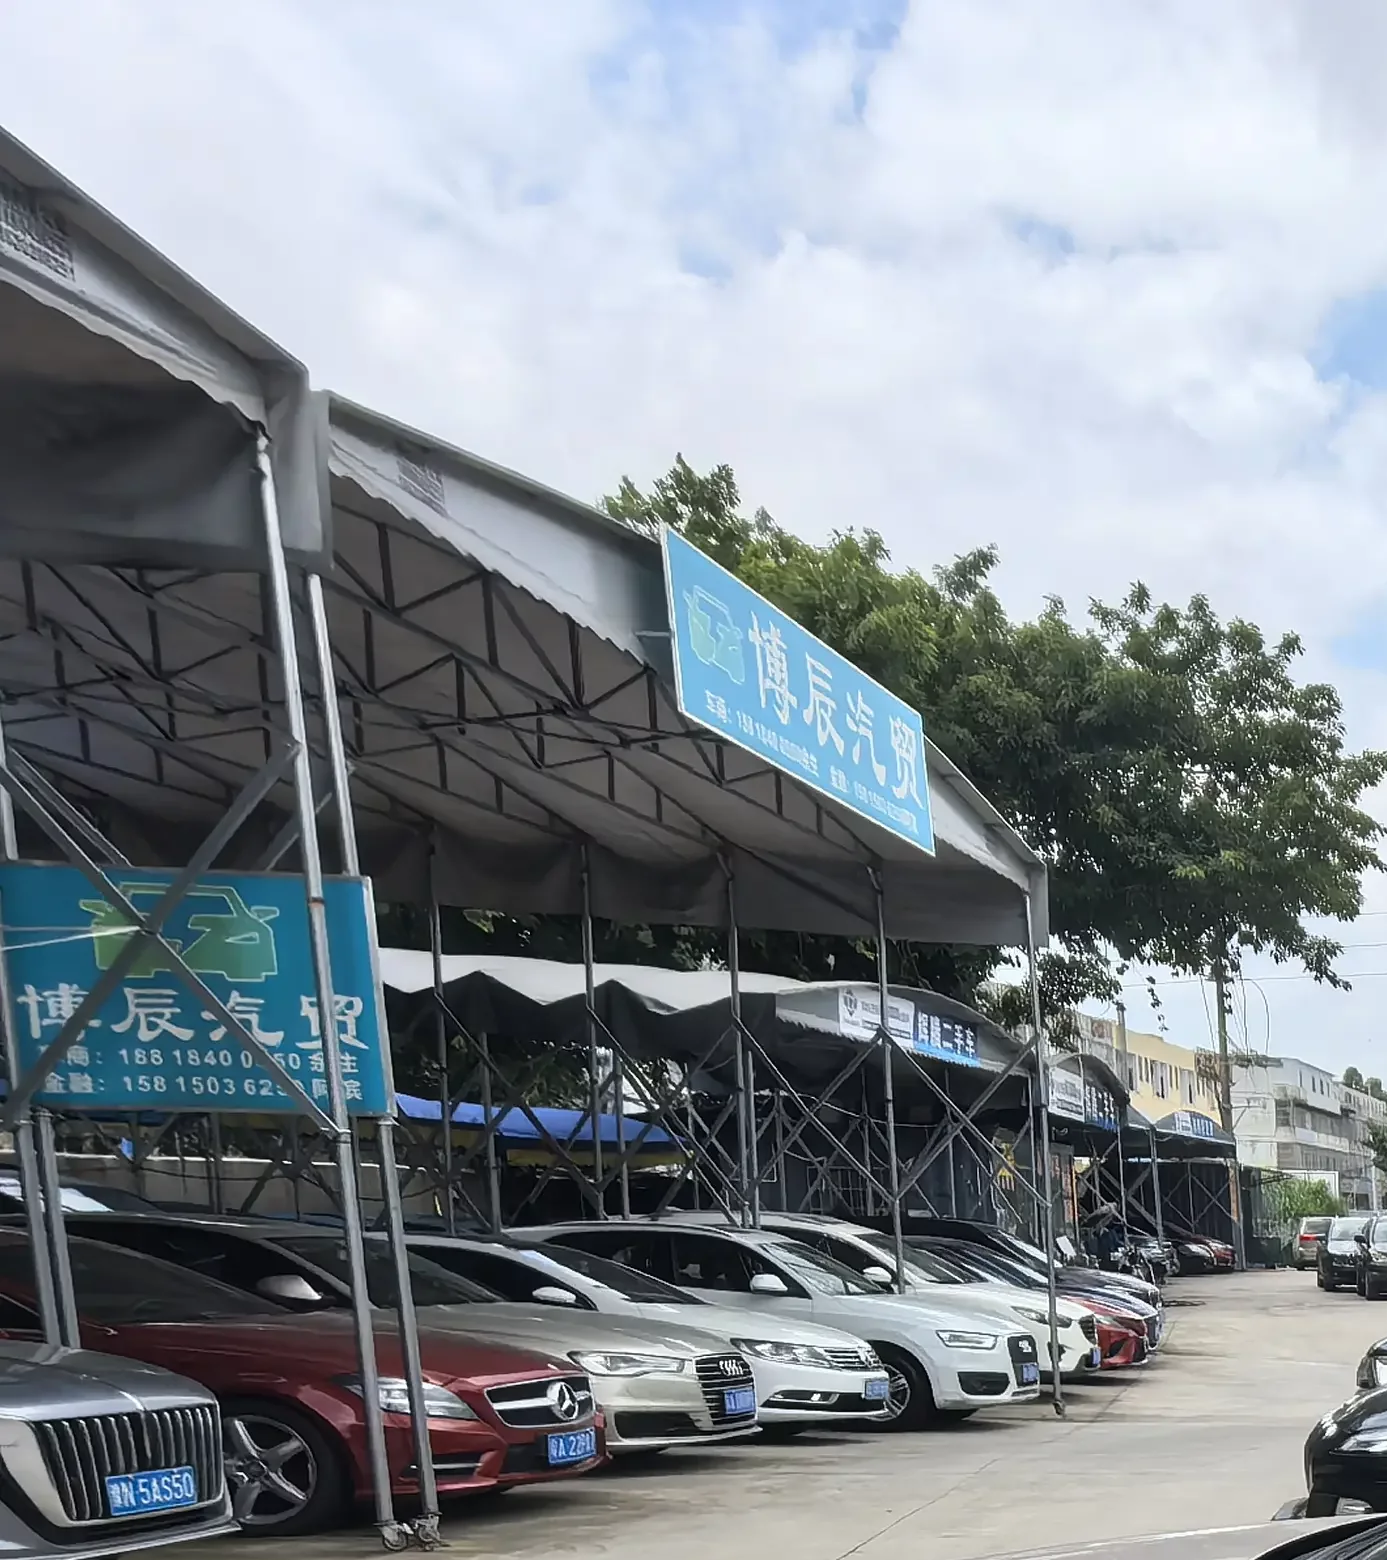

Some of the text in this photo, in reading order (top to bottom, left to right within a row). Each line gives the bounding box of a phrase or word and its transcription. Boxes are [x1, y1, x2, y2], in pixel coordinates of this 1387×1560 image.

[748, 610, 926, 810] 博辰汽贸
[17, 983, 369, 1050] 博辰汽贸
[172, 1049, 232, 1067] 1840
[240, 1050, 301, 1070] 050
[123, 1075, 167, 1093] 158
[175, 1075, 236, 1096] 1503
